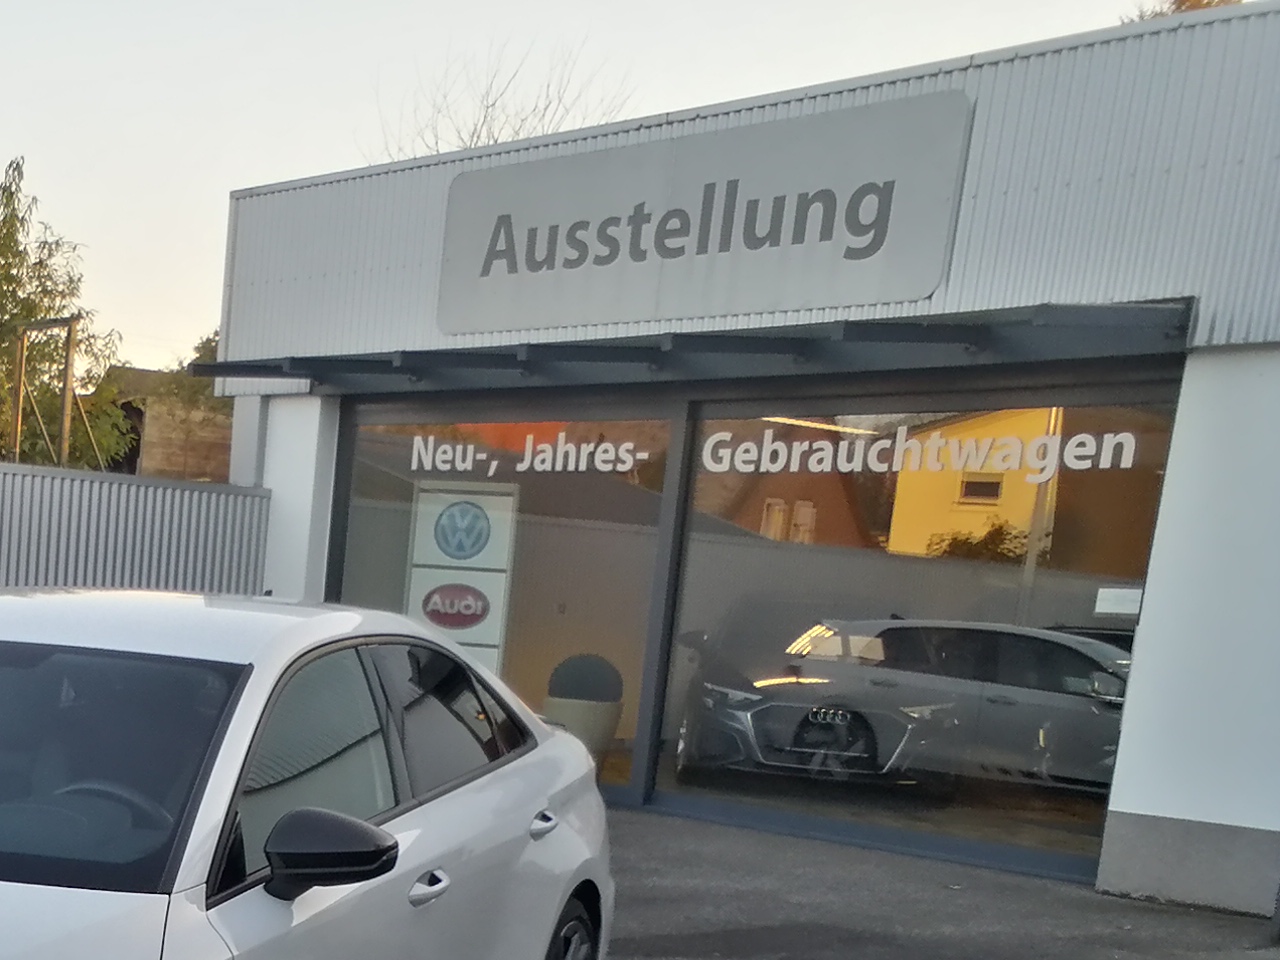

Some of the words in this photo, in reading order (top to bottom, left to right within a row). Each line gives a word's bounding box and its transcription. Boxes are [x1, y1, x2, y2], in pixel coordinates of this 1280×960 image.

[479, 178, 897, 279] Ausstellung
[410, 435, 500, 477] Neu-,
[516, 431, 650, 473] Jahres-
[702, 426, 1137, 484] Gebrauchtwagen
[425, 593, 483, 616] Audi
